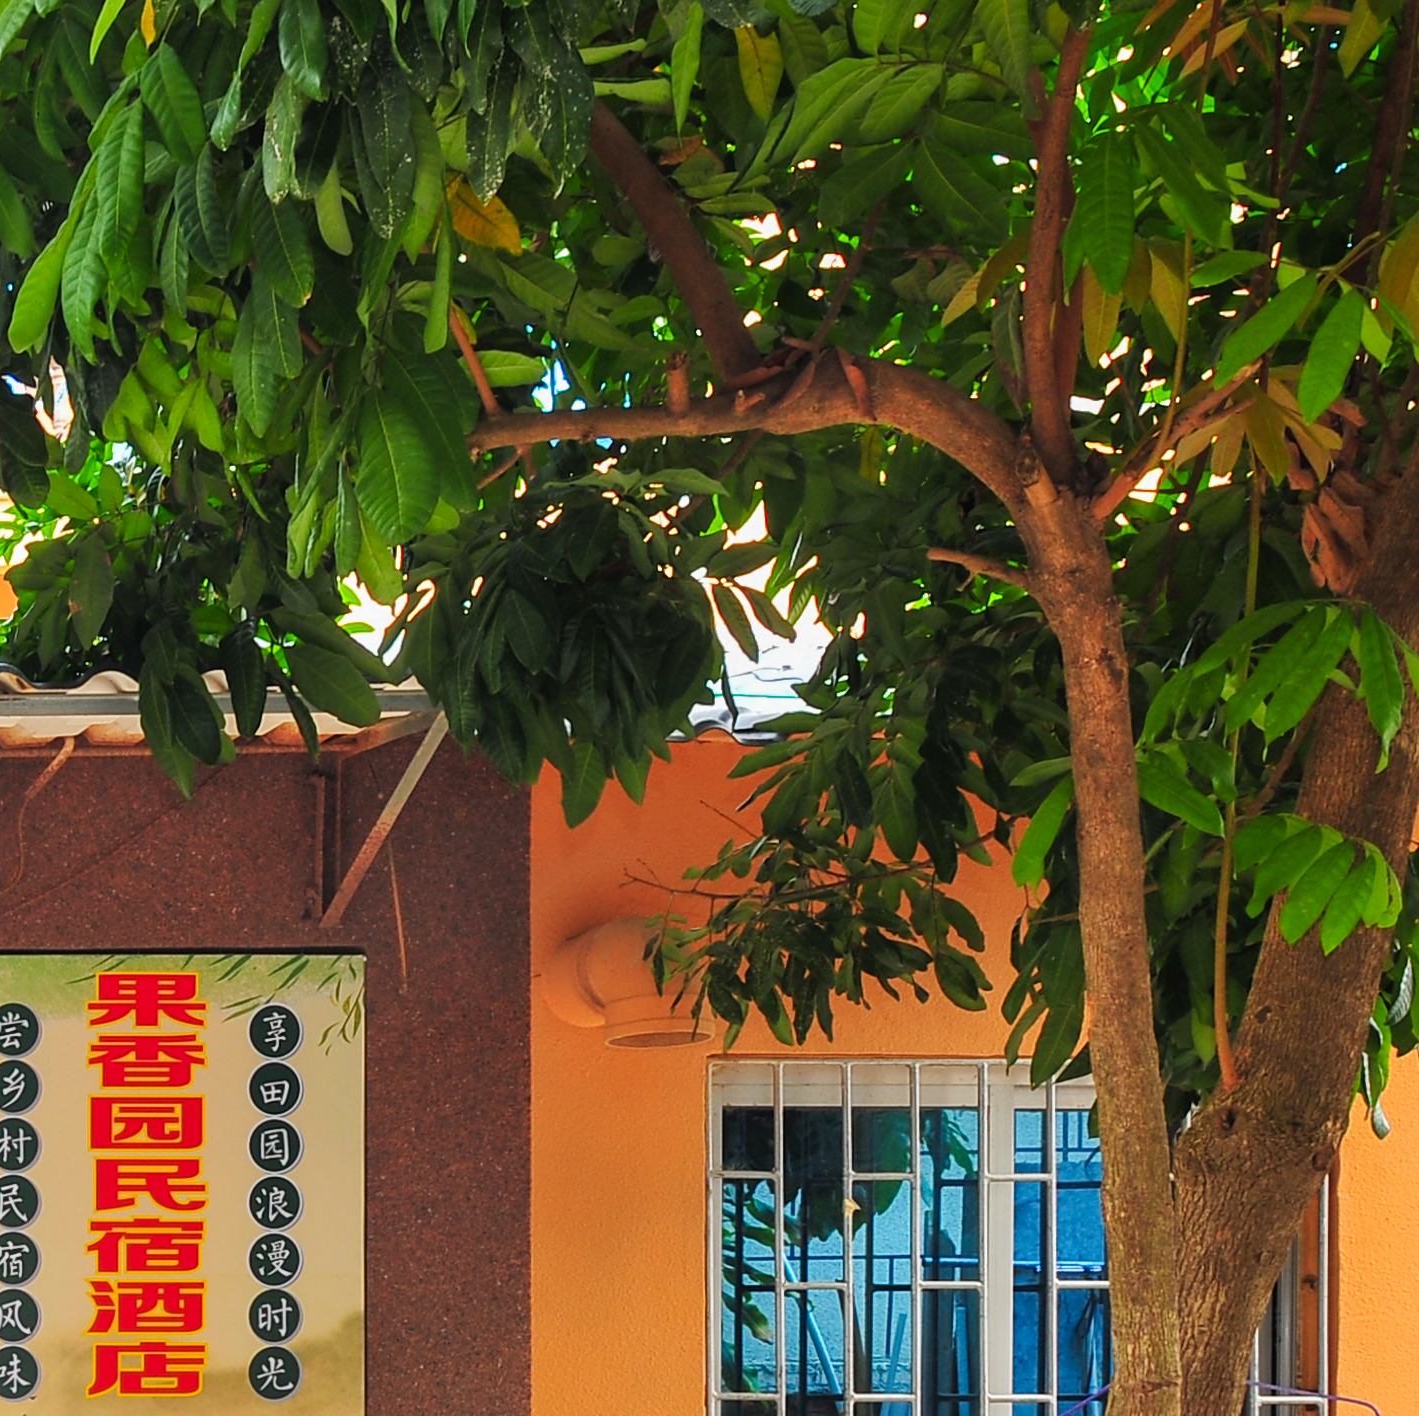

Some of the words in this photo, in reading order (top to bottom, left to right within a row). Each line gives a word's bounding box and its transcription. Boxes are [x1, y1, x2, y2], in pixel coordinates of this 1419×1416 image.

[85, 970, 209, 1398] 果香园民宿酒店
[256, 1010, 295, 1394] 享田园浪漫时光
